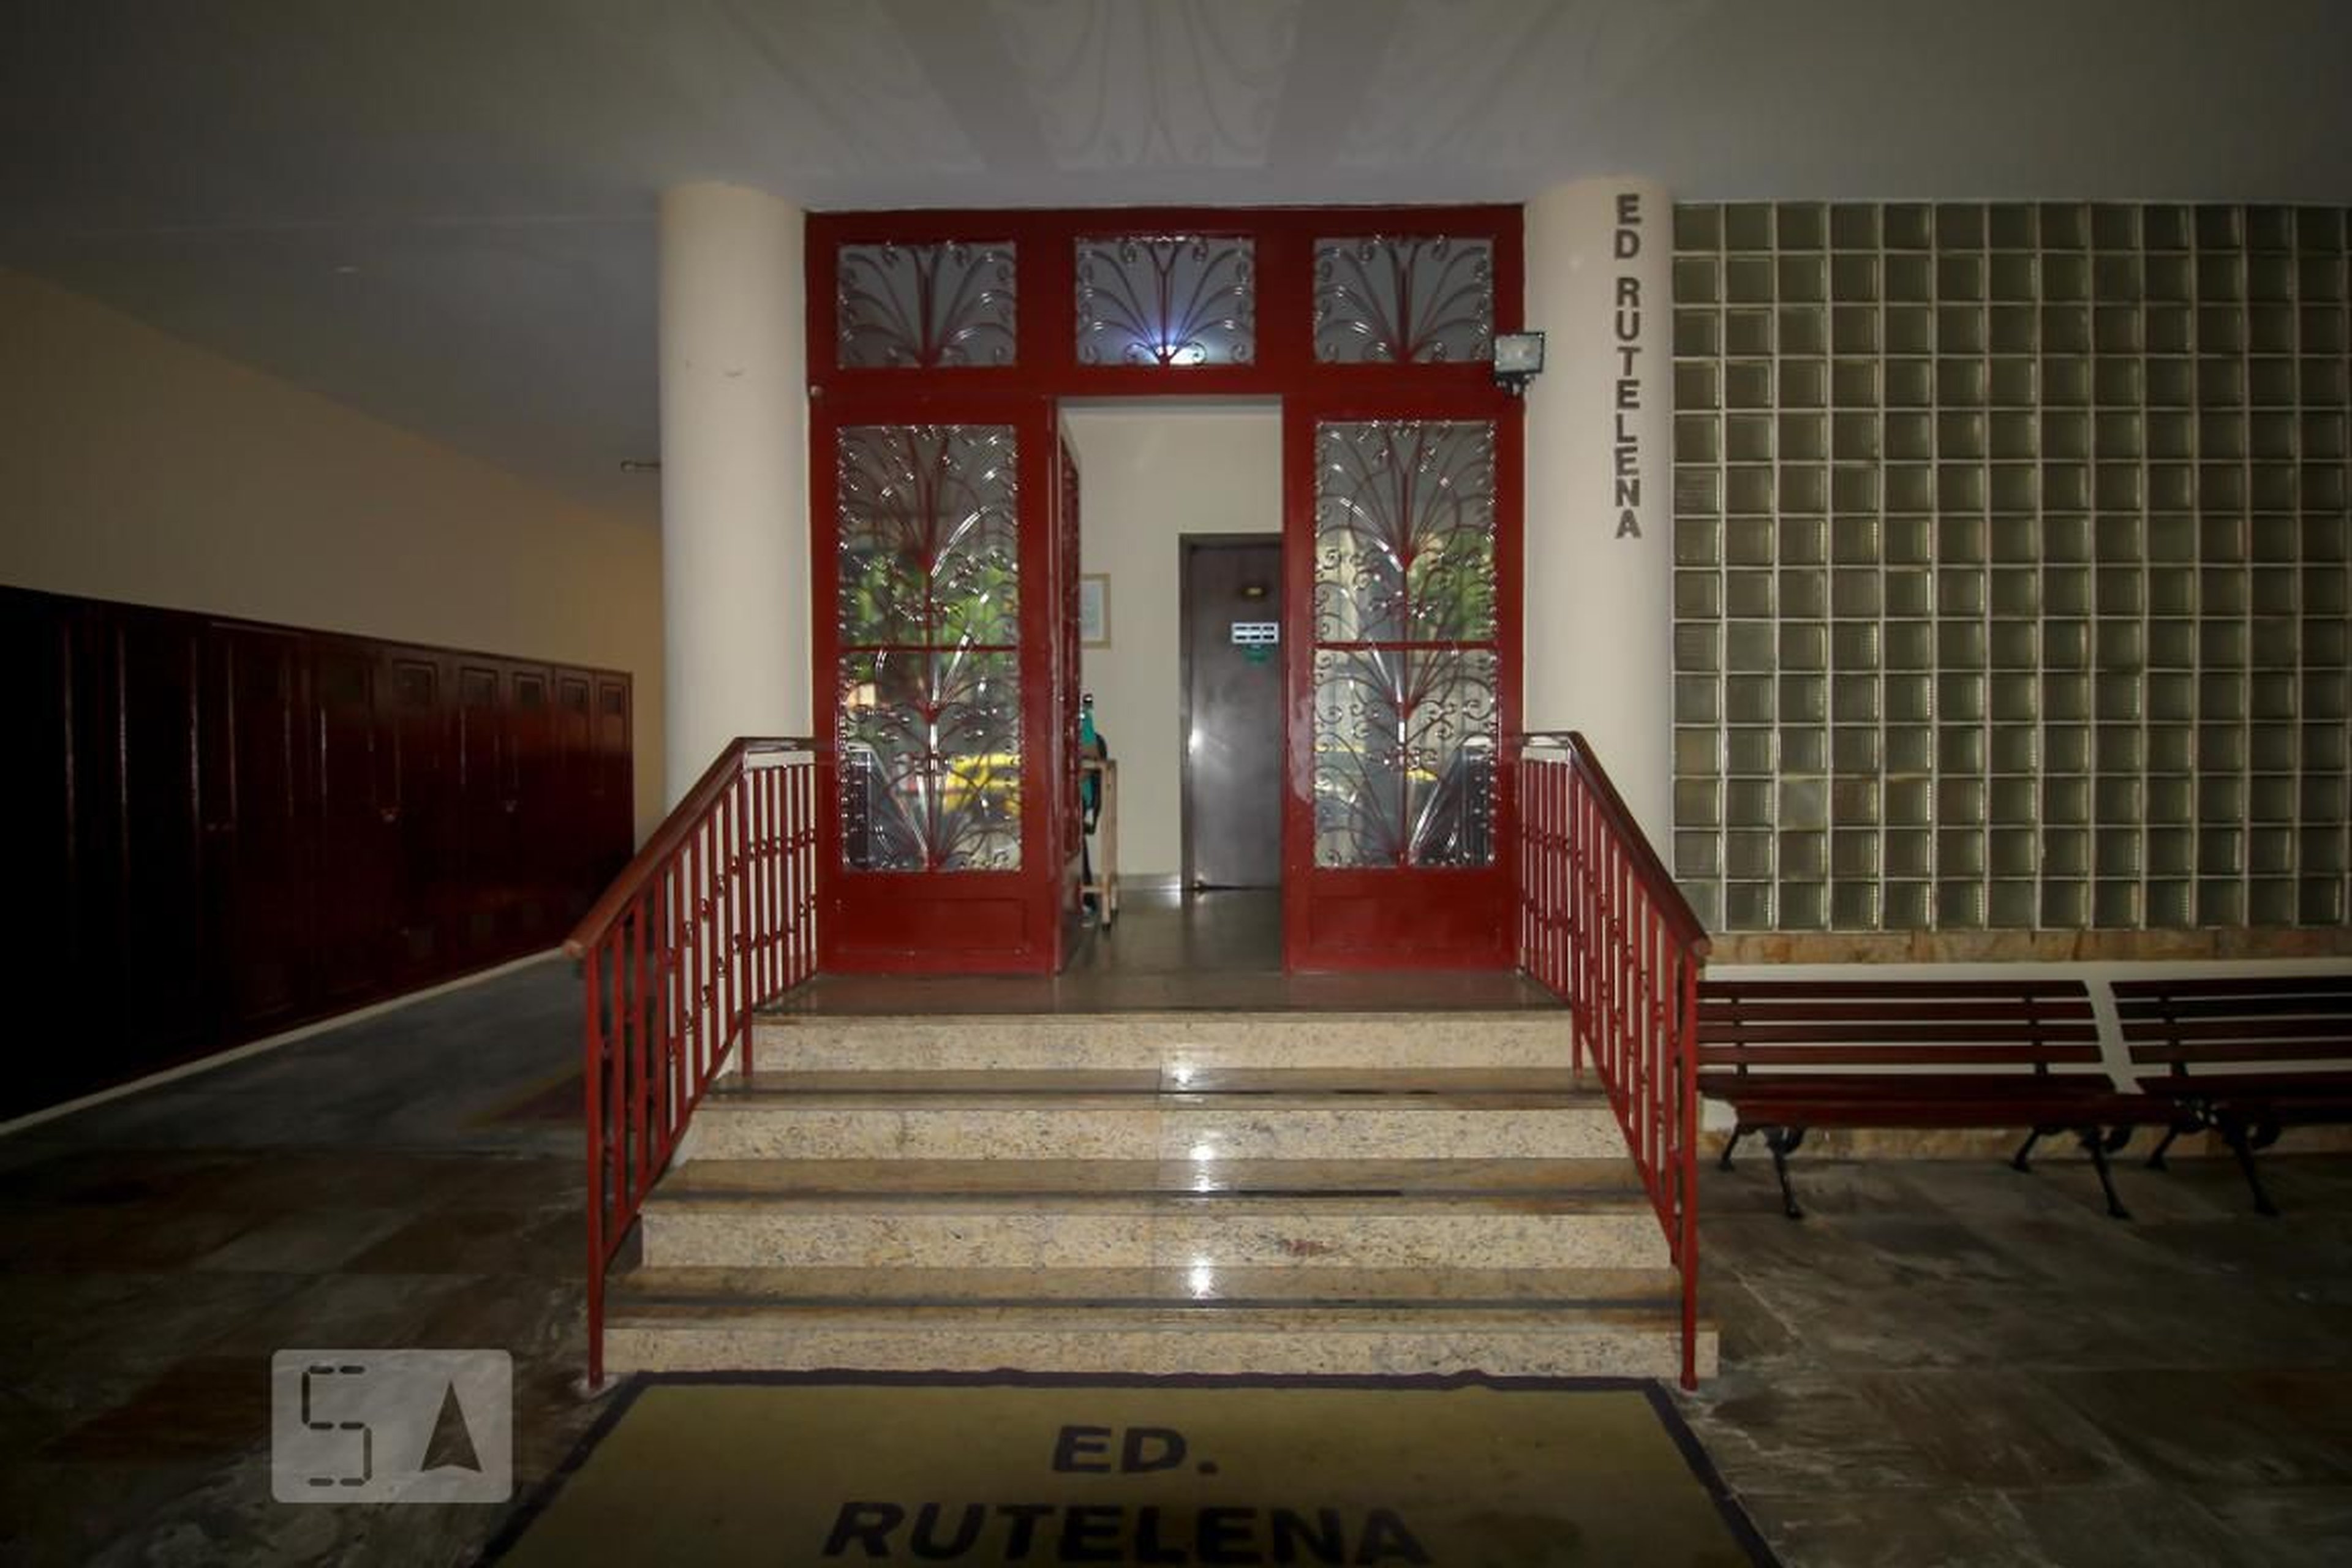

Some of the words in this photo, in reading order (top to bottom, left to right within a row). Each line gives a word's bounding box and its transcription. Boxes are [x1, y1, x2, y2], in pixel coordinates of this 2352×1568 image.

[1615, 194, 1642, 259] ED
[1615, 277, 1642, 539] RUTELENA
[1052, 1425, 1218, 1474] ED.
[822, 1502, 1430, 1567] RUTELENA
